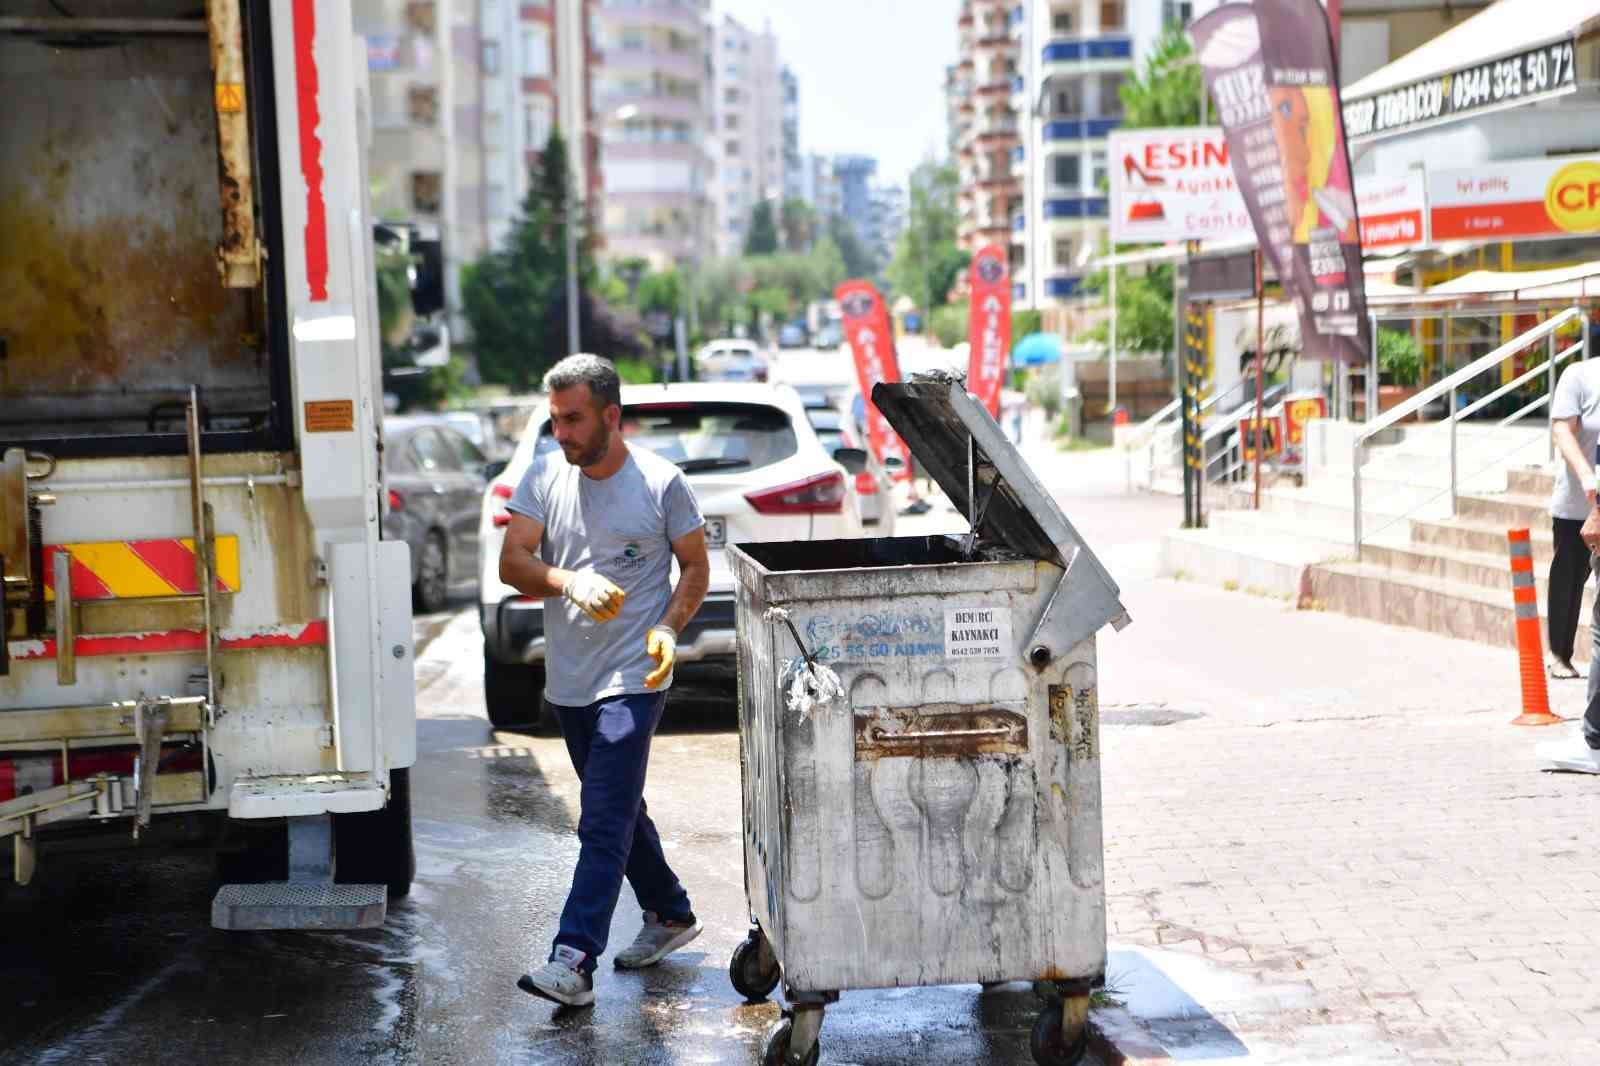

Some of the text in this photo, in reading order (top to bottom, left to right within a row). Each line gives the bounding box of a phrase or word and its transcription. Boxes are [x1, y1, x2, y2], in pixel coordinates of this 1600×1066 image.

[1453, 68, 1490, 108] 0544
[1493, 57, 1522, 98] 325
[1527, 50, 1548, 92] 50
[1552, 41, 1574, 85] 72
